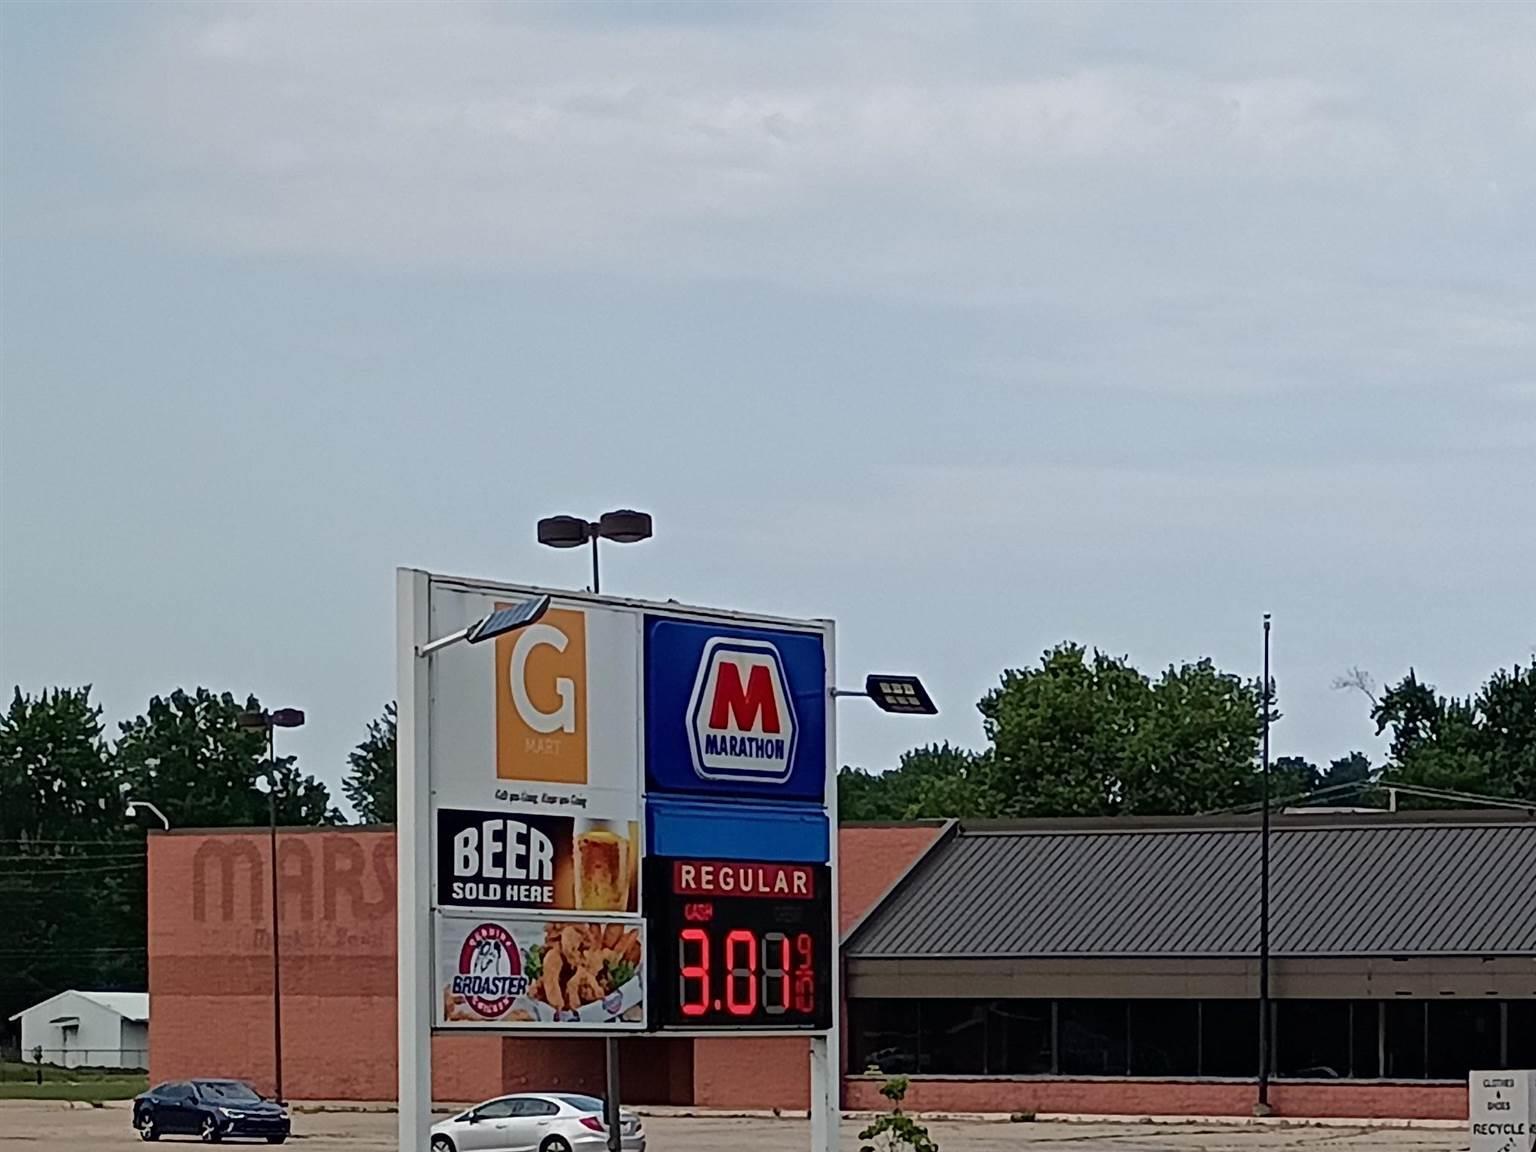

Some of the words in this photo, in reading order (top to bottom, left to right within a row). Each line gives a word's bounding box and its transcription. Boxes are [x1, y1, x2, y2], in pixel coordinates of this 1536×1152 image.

[510, 623, 575, 734] G
[708, 661, 781, 734] M
[525, 738, 561, 755] MART
[705, 734, 784, 760] MARATHON
[454, 819, 554, 880] BEER
[452, 882, 501, 900] SOLD
[506, 884, 554, 903] HERE
[681, 865, 807, 894] REGULAR
[453, 975, 528, 996] BROASTER
[1473, 1123, 1525, 1135] RECYCLE
